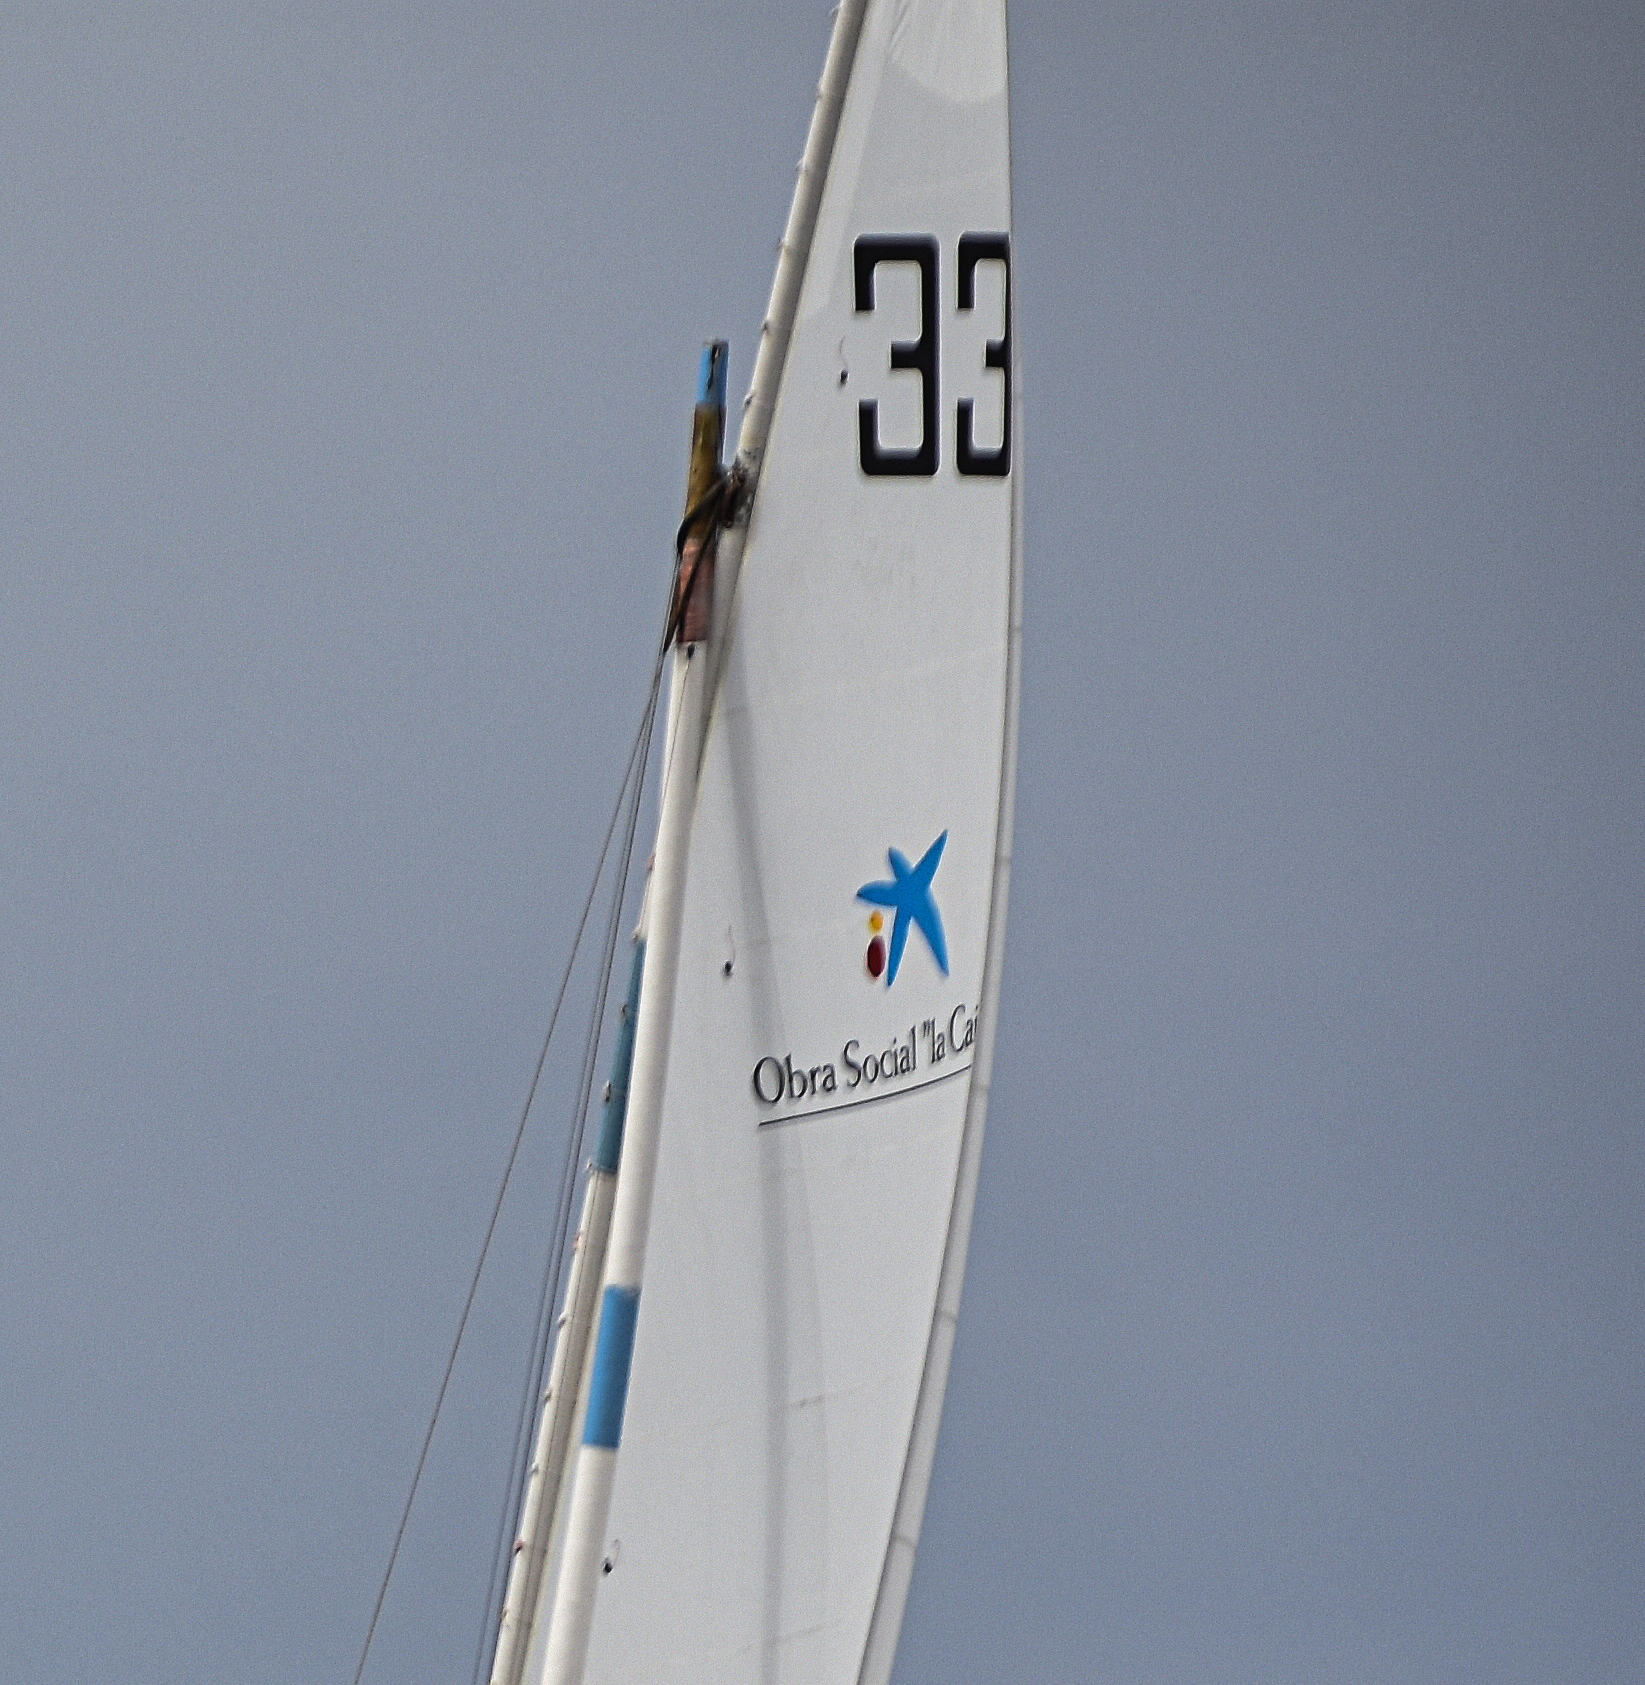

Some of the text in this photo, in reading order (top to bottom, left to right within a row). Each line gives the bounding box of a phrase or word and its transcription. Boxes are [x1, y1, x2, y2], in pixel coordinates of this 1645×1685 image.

[853, 230, 1012, 476] 33
[753, 1054, 838, 1104] Obra
[843, 1025, 918, 1088] Social
